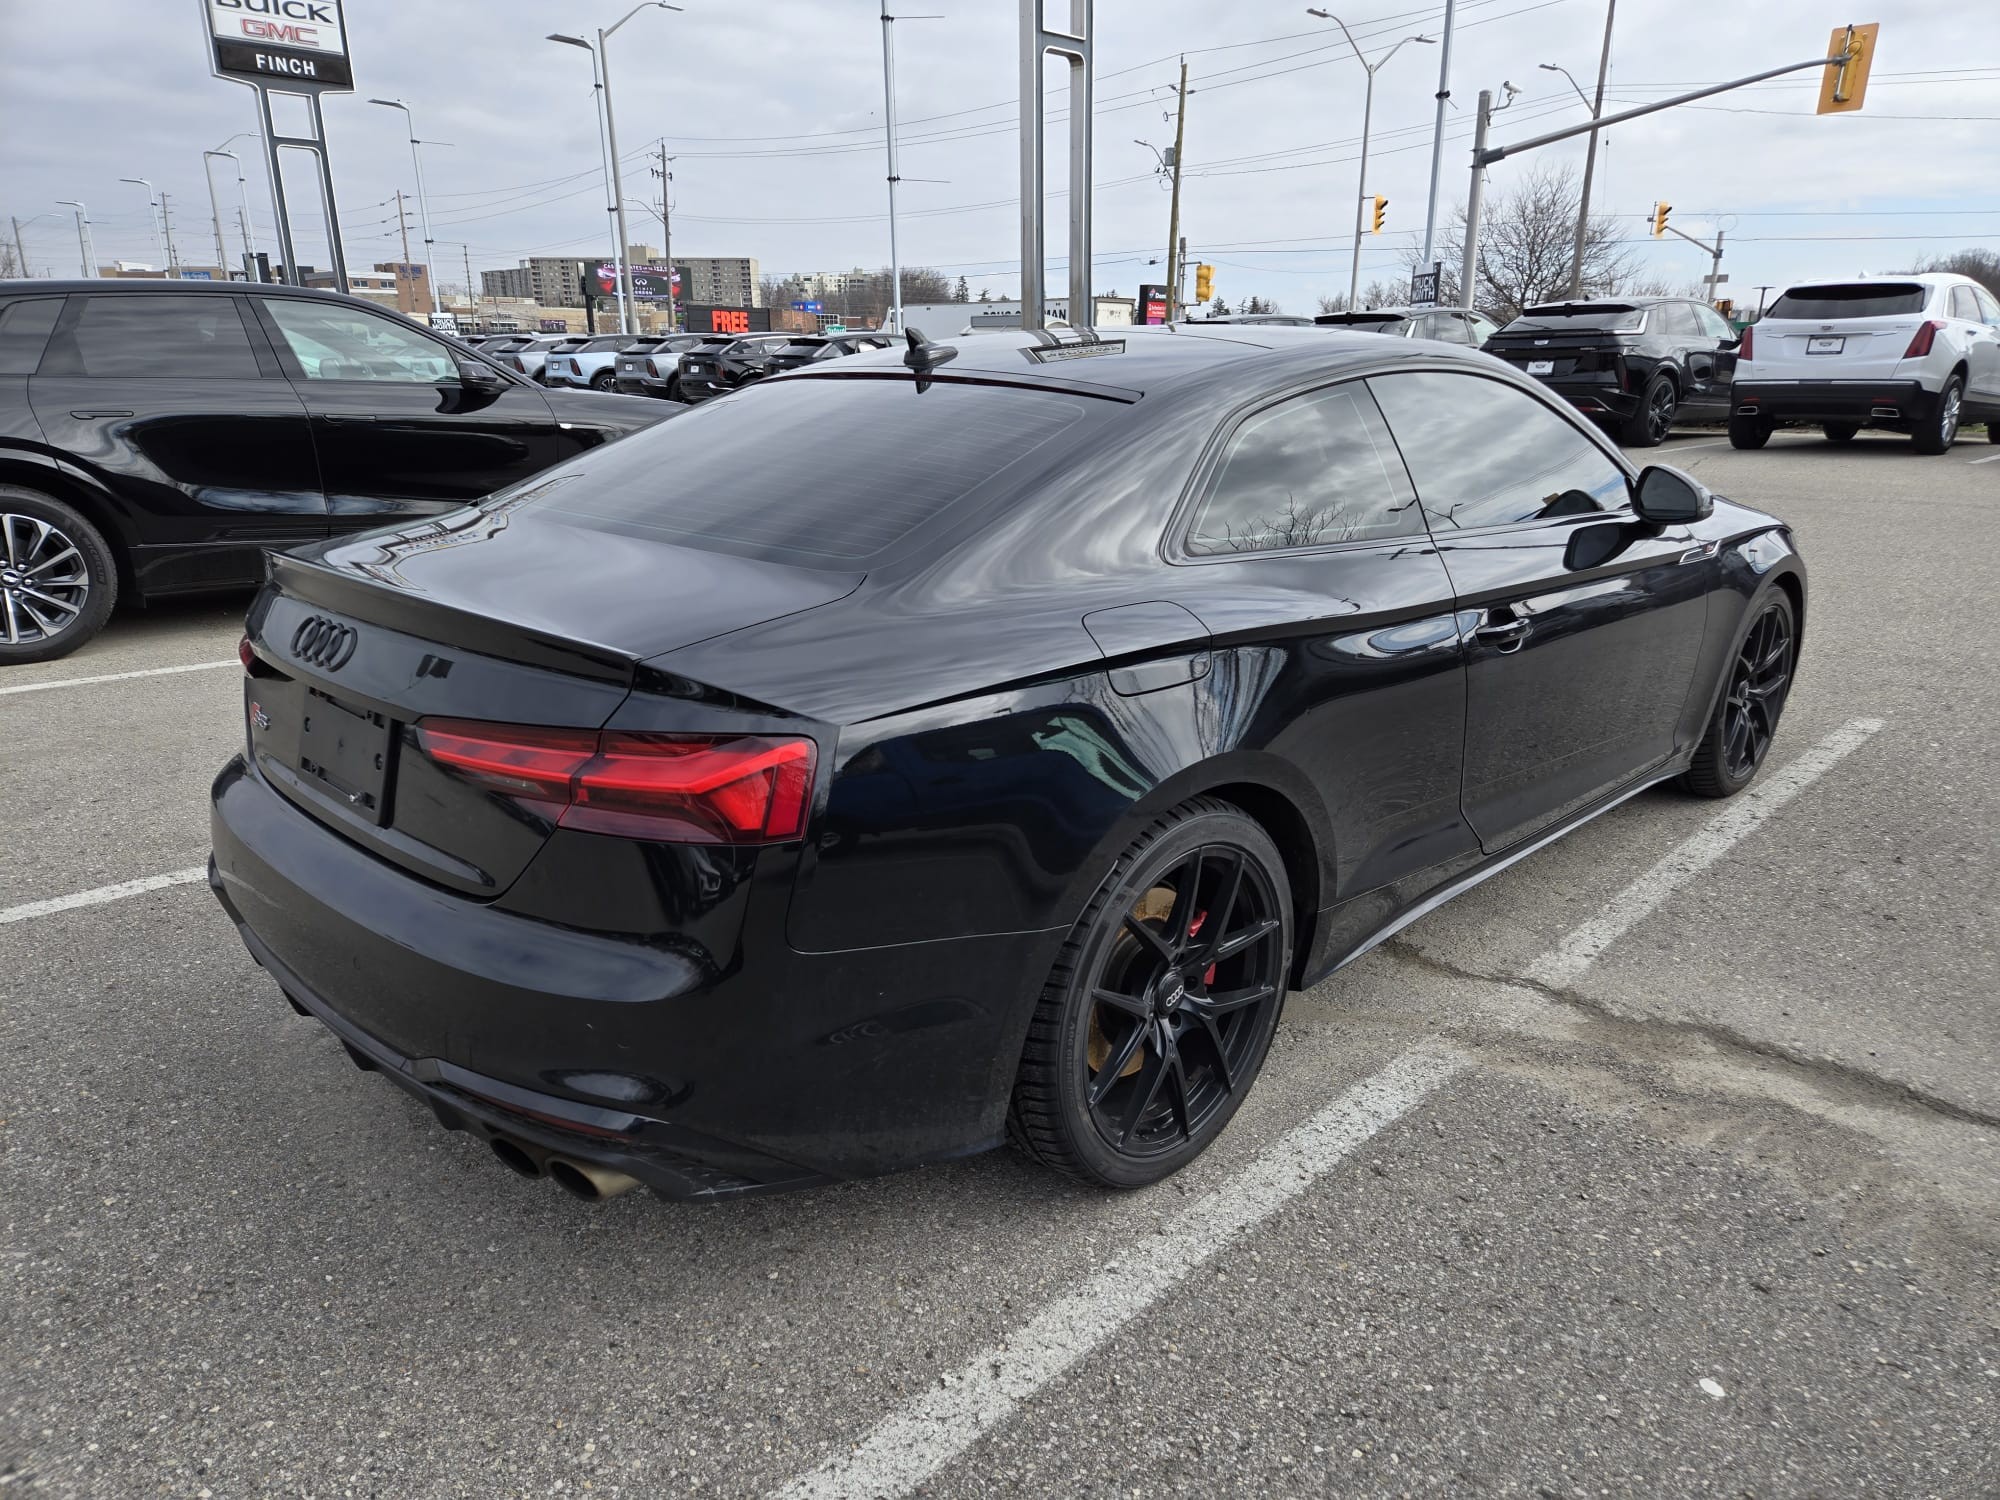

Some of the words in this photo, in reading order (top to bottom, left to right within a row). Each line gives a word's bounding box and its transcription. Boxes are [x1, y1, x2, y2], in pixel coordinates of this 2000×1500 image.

[241, 18, 320, 47] GMC
[255, 53, 316, 76] FINCH
[711, 310, 749, 333] FREE
